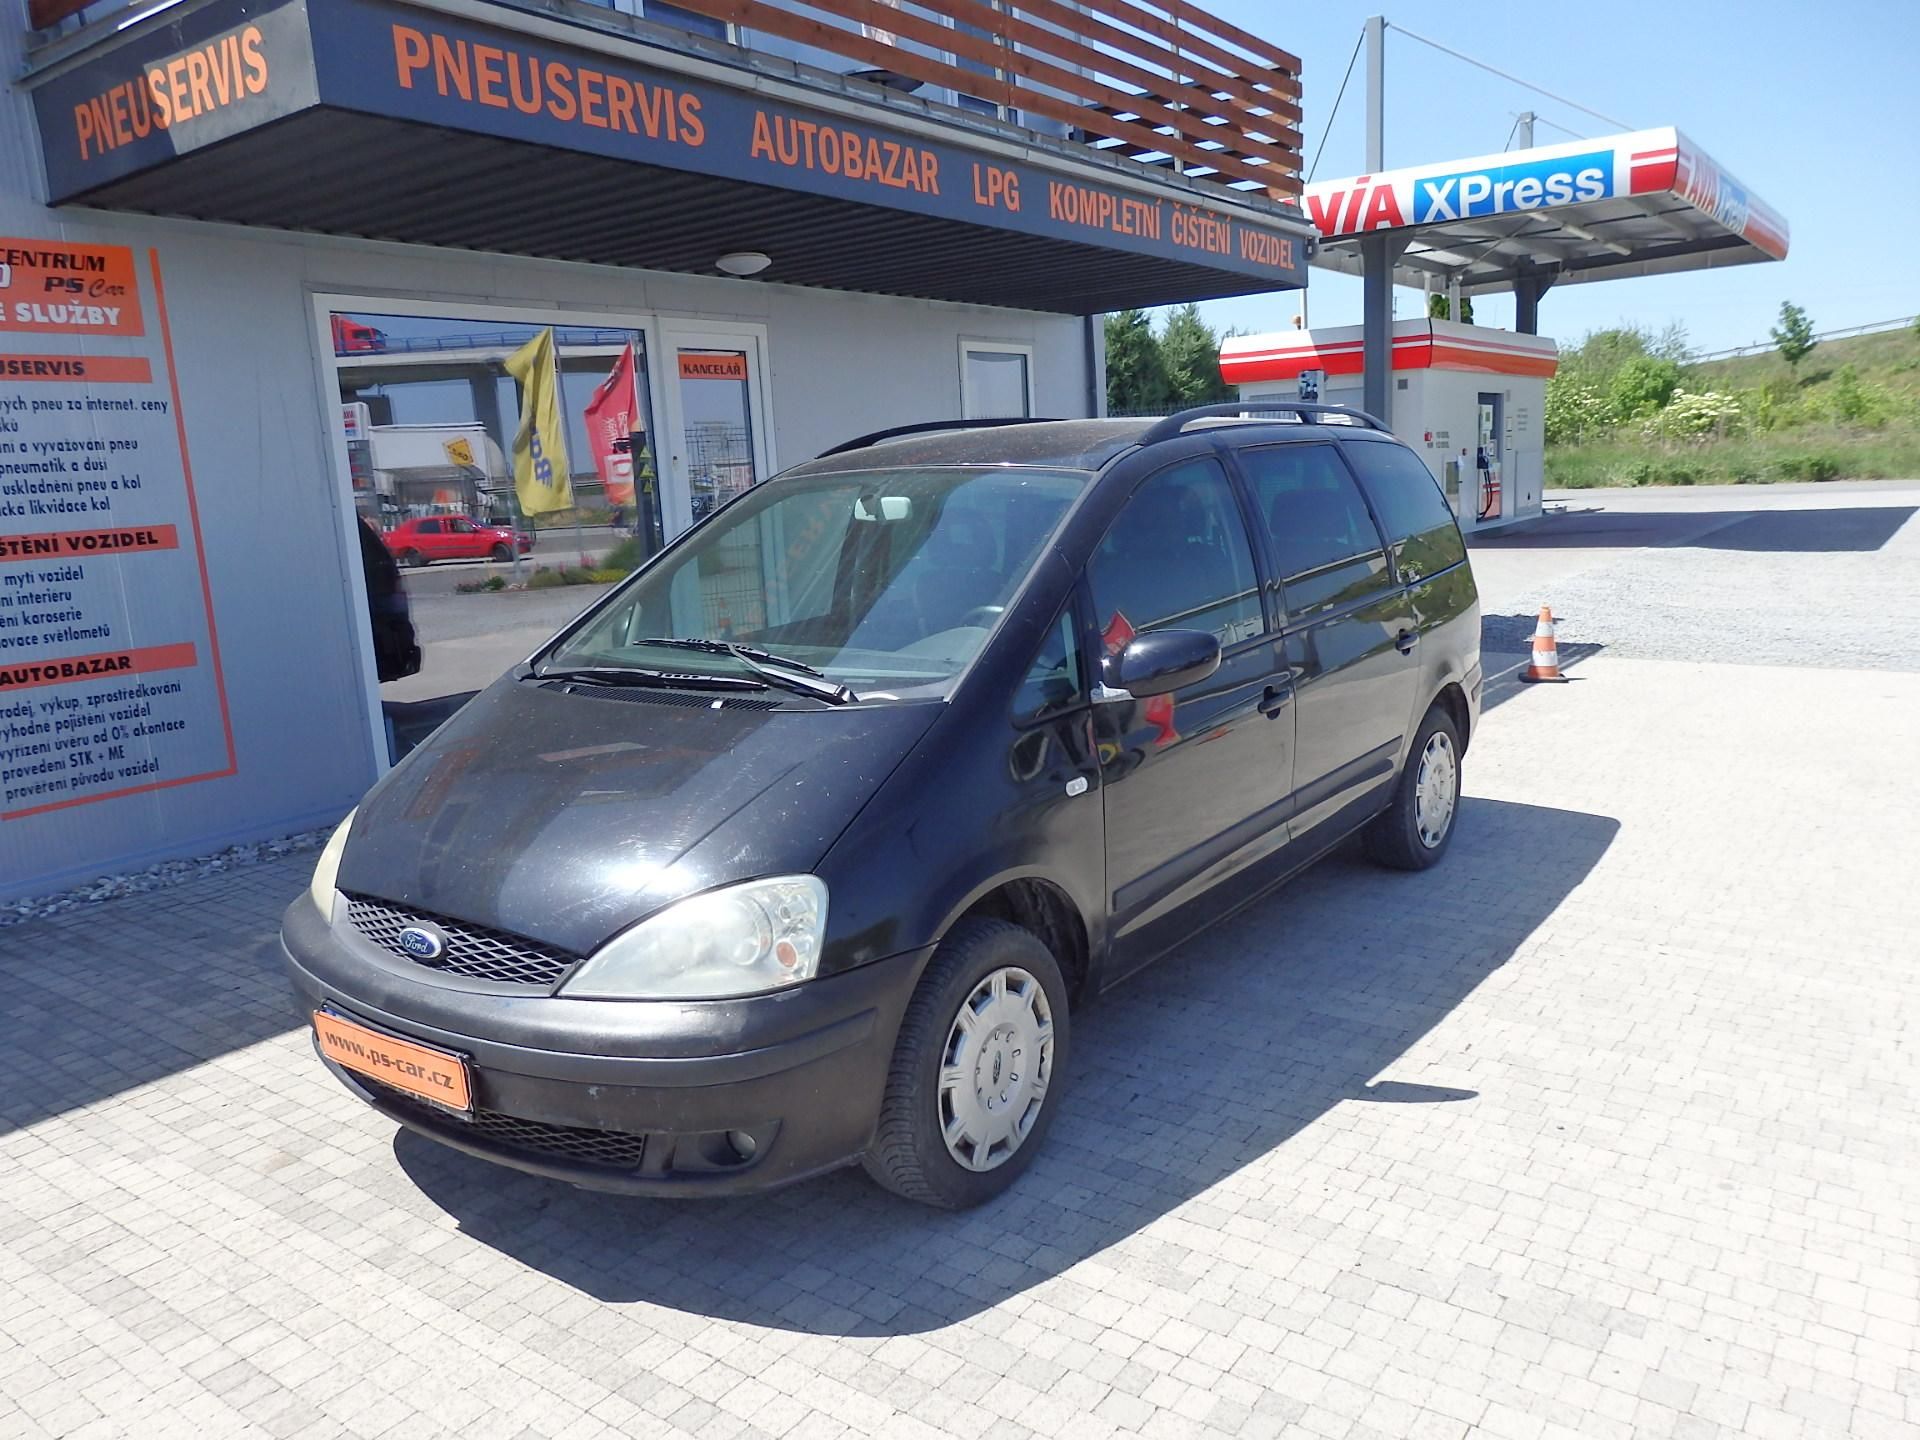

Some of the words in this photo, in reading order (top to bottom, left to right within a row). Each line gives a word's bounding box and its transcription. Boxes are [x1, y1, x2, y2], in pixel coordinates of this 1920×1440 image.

[74, 26, 268, 160] PNEUSERVIS
[392, 24, 705, 146] PNEUSERVIS
[750, 110, 940, 195] AUTOBAZAR
[973, 163, 1020, 212] LPG
[1424, 167, 1605, 222] XPress
[1306, 176, 1405, 237] VIA
[1049, 181, 1161, 240] KOMPLETNÍ
[1171, 202, 1231, 256] ČIŠTĚNÍ
[1239, 228, 1295, 271] VOZIDEL
[0, 248, 105, 272] ENTRUM
[44, 276, 85, 294] PS
[88, 278, 125, 298] Car
[15, 299, 121, 326] SLUŽBY
[683, 362, 741, 376] KANCELÁŘ
[32, 399, 63, 414] pneu
[67, 400, 82, 411] za
[86, 396, 138, 411] internet.
[141, 401, 168, 414] ceny
[20, 443, 28, 453] a
[109, 439, 138, 454] pneu
[0, 457, 67, 478] pneumatik
[72, 461, 79, 472] a
[3, 478, 73, 496] uskladnění
[77, 480, 107, 495] pneu
[111, 480, 118, 490] a
[122, 474, 141, 490] kol
[29, 498, 87, 515] likvidace
[91, 496, 111, 512] kol
[66, 531, 158, 551] VOZIDEL
[38, 565, 84, 582] vozidel
[0, 594, 13, 607] ní
[22, 606, 82, 625] karoserie
[43, 624, 110, 643] světlometů
[0, 655, 132, 686] AUTOBAZAR
[109, 702, 151, 722] vozidel
[93, 727, 108, 743] od
[133, 718, 185, 737] akontace
[2, 758, 65, 785] provedení
[69, 752, 94, 768] STK
[108, 745, 125, 761] ME
[118, 758, 160, 777] vozidel
[404, 933, 428, 953] Ford
[324, 1031, 455, 1090] www.ps-car.cz
